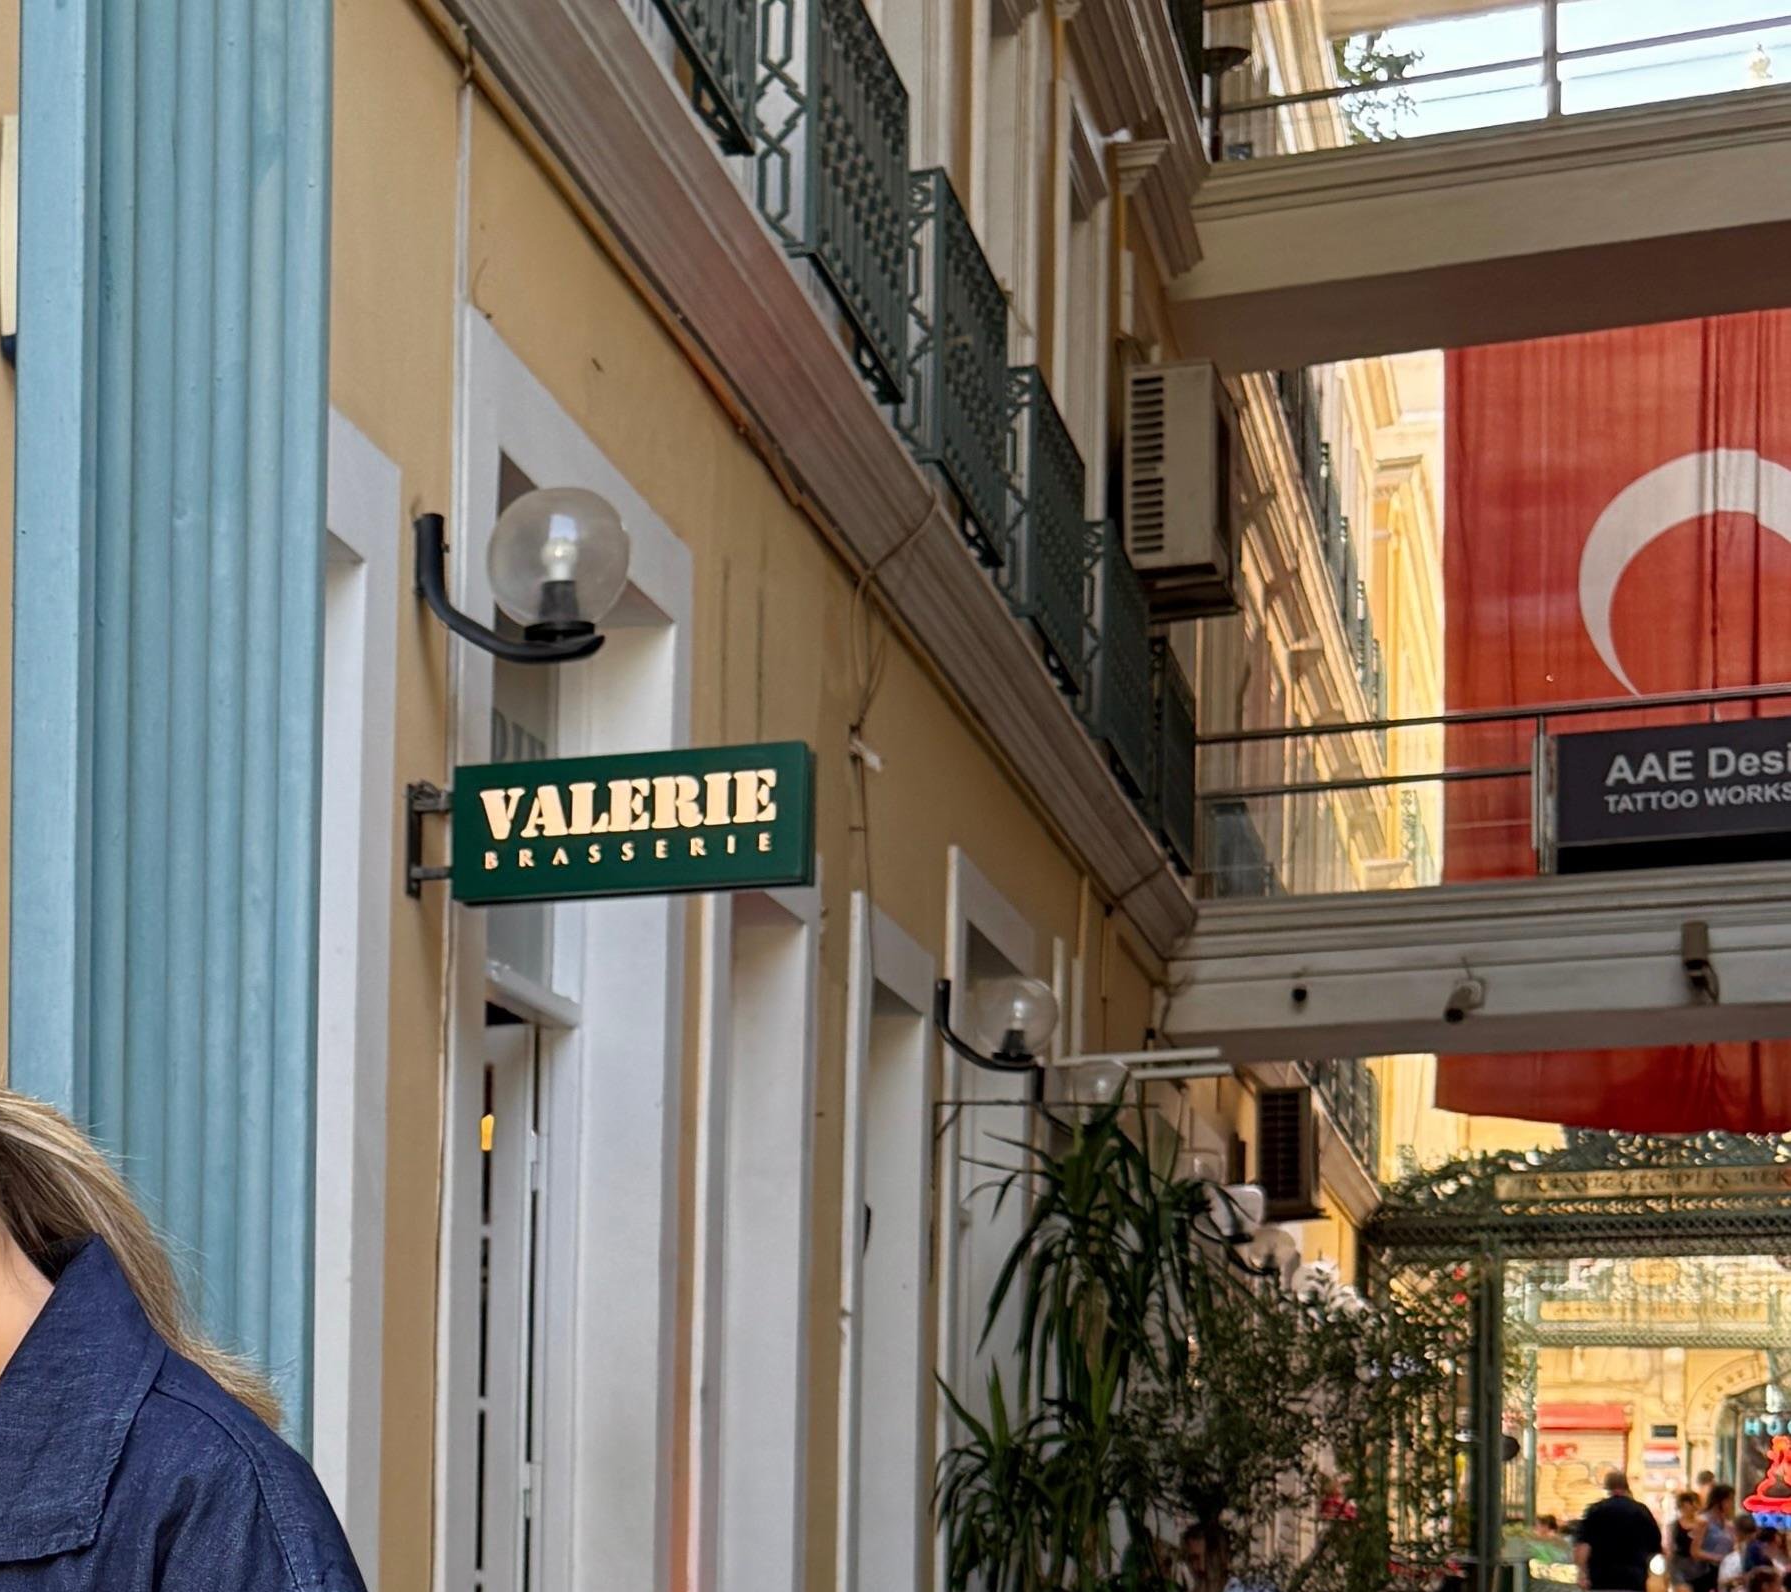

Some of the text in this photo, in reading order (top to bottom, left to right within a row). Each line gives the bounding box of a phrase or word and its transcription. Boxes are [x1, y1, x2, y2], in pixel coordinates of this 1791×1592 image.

[1604, 750, 1695, 787] AAE
[480, 769, 777, 840] VALERIE
[1603, 781, 1791, 814] TATTOO WORKS
[483, 832, 773, 870] BRASSERIE
